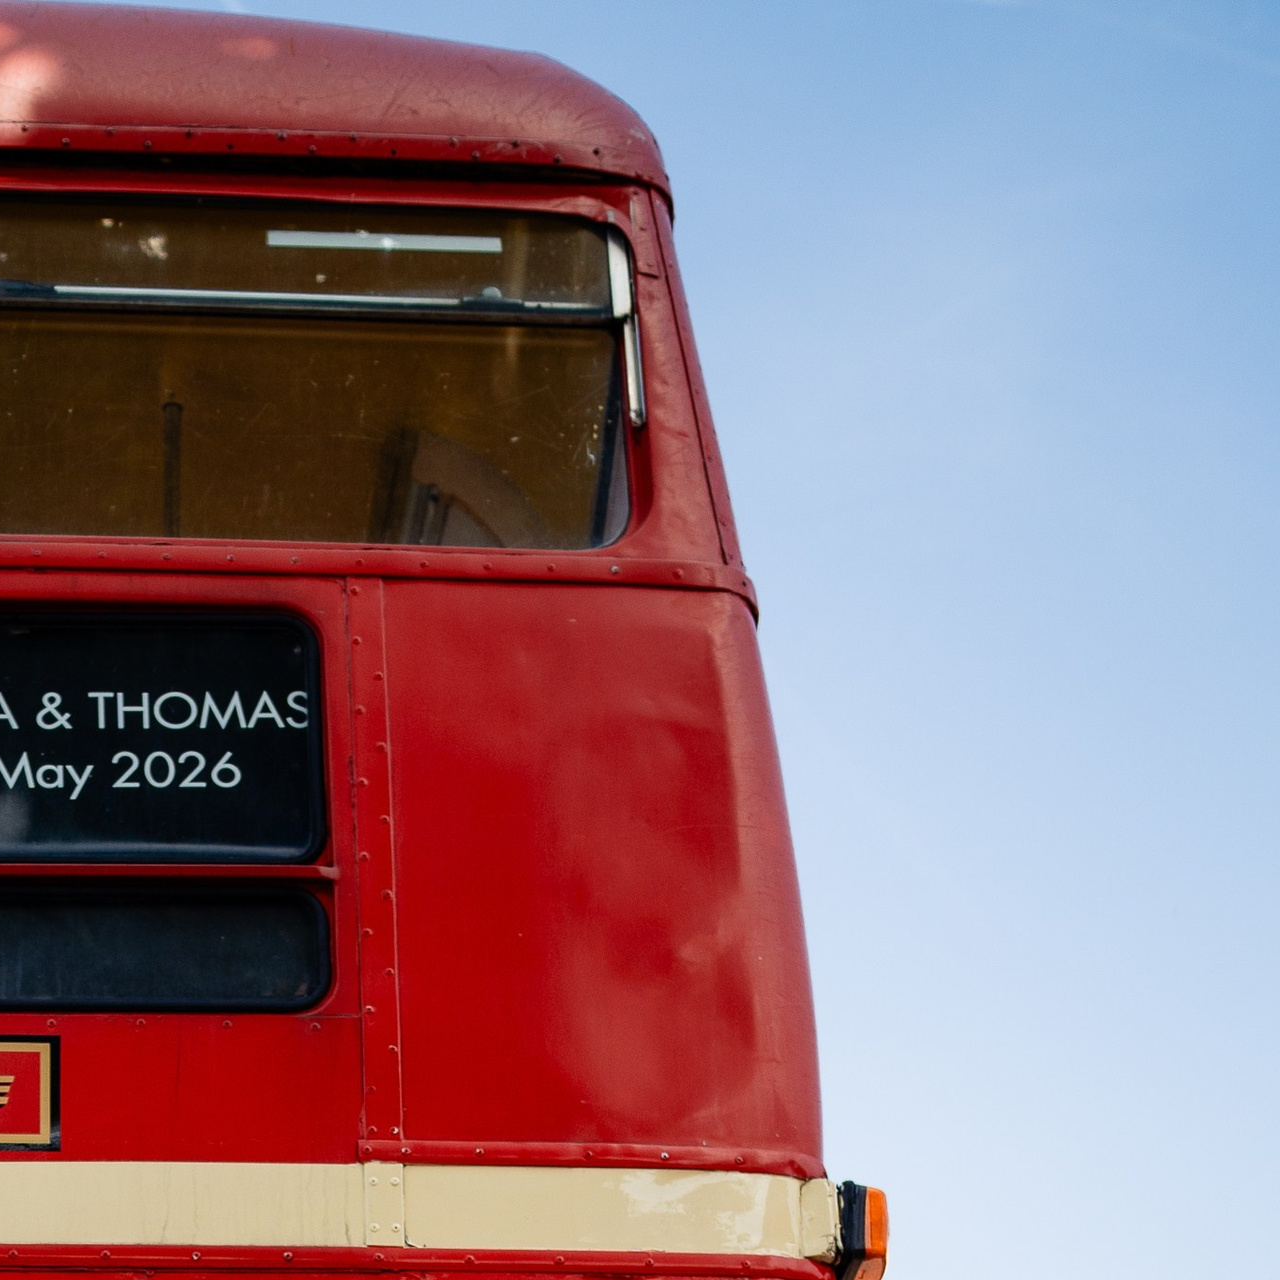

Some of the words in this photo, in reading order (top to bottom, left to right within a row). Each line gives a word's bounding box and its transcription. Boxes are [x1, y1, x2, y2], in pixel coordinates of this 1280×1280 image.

[36, 691, 73, 731] &
[87, 690, 308, 731] THOMAS
[111, 750, 242, 788] 2026
